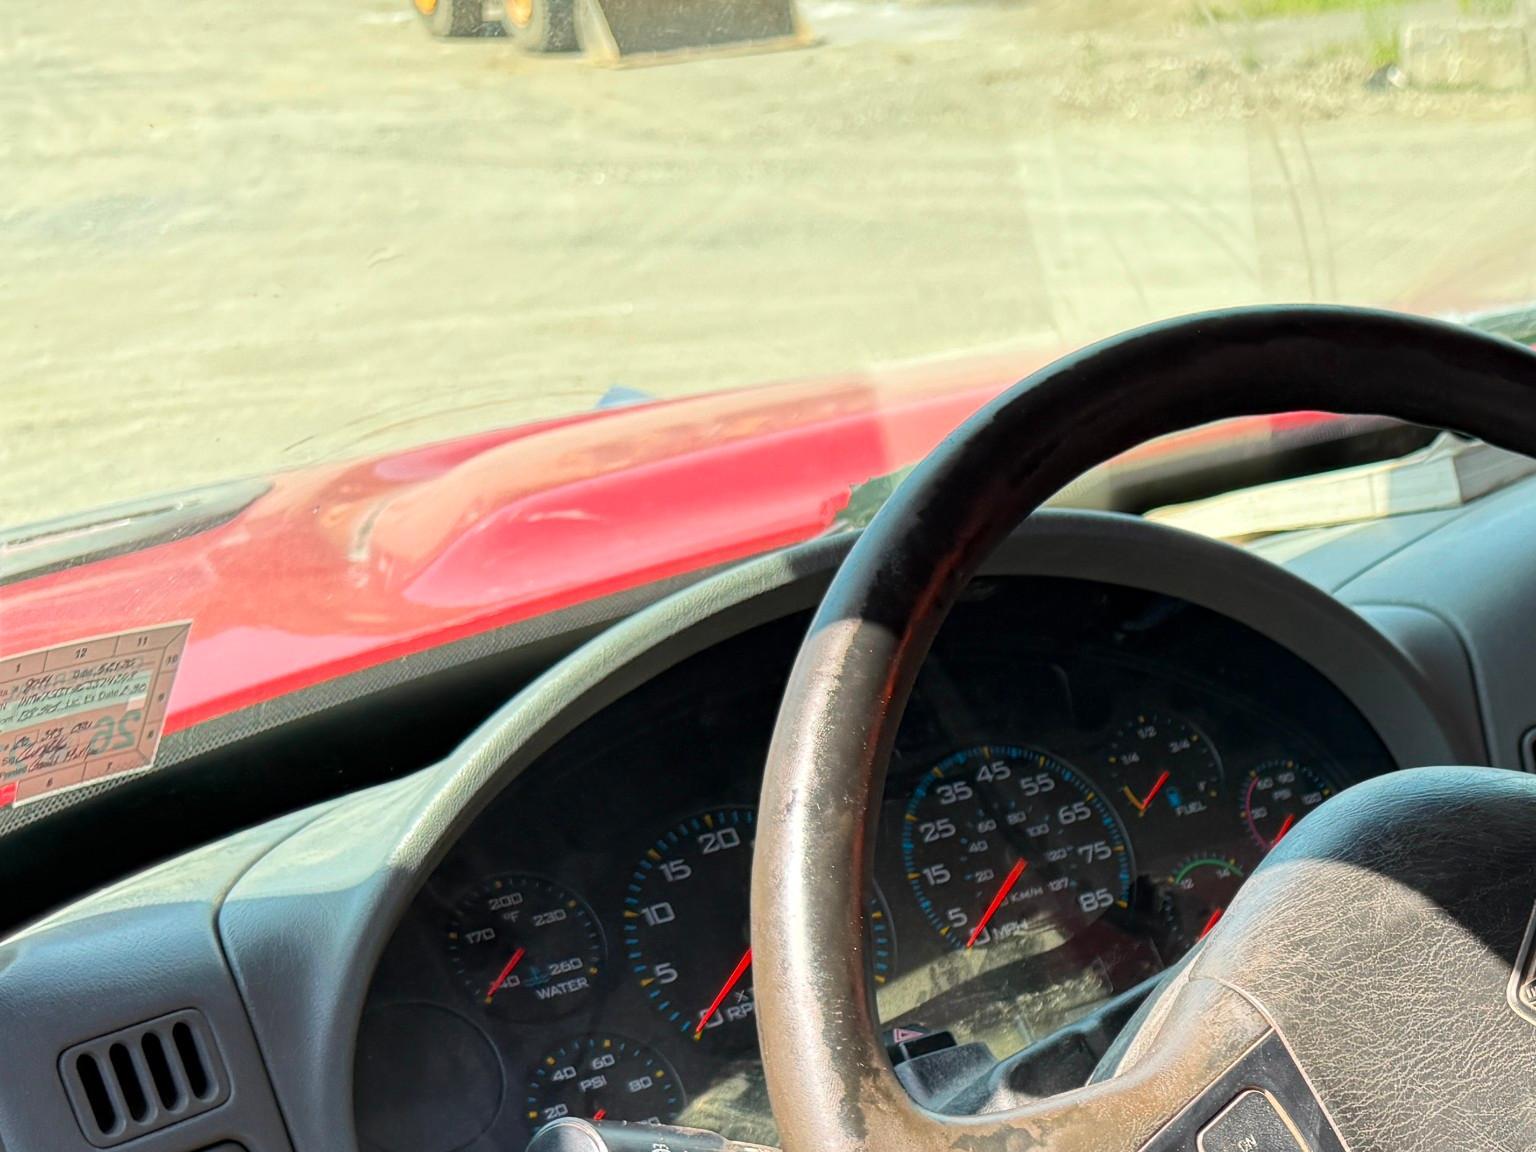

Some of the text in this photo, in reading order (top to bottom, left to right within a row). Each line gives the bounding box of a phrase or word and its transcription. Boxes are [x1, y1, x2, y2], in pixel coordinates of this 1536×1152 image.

[75, 648, 88, 658] 12
[976, 760, 1011, 783] 45
[936, 781, 973, 805] 35
[1019, 773, 1055, 796] 55
[1058, 801, 1091, 825] 65
[919, 818, 956, 843] 25
[697, 827, 741, 855] 20
[1078, 841, 1112, 864] 75
[658, 858, 692, 883] 15
[922, 864, 951, 886] 15
[975, 869, 994, 883] 20
[488, 892, 523, 911] 200
[1079, 888, 1114, 913] 85
[533, 909, 567, 927] 230
[641, 901, 676, 926] 10
[947, 908, 968, 928] 5
[465, 927, 496, 944] 170
[548, 957, 584, 976] 260
[654, 962, 678, 984] 5
[536, 976, 590, 1000] WATER
[727, 1001, 755, 1021] RP
[591, 1053, 615, 1070] 60
[552, 1066, 577, 1082] 40
[580, 1074, 608, 1092] PSI
[628, 1075, 653, 1093] 80
[544, 1103, 569, 1120] 20
[1237, 1135, 1258, 1152] ON
